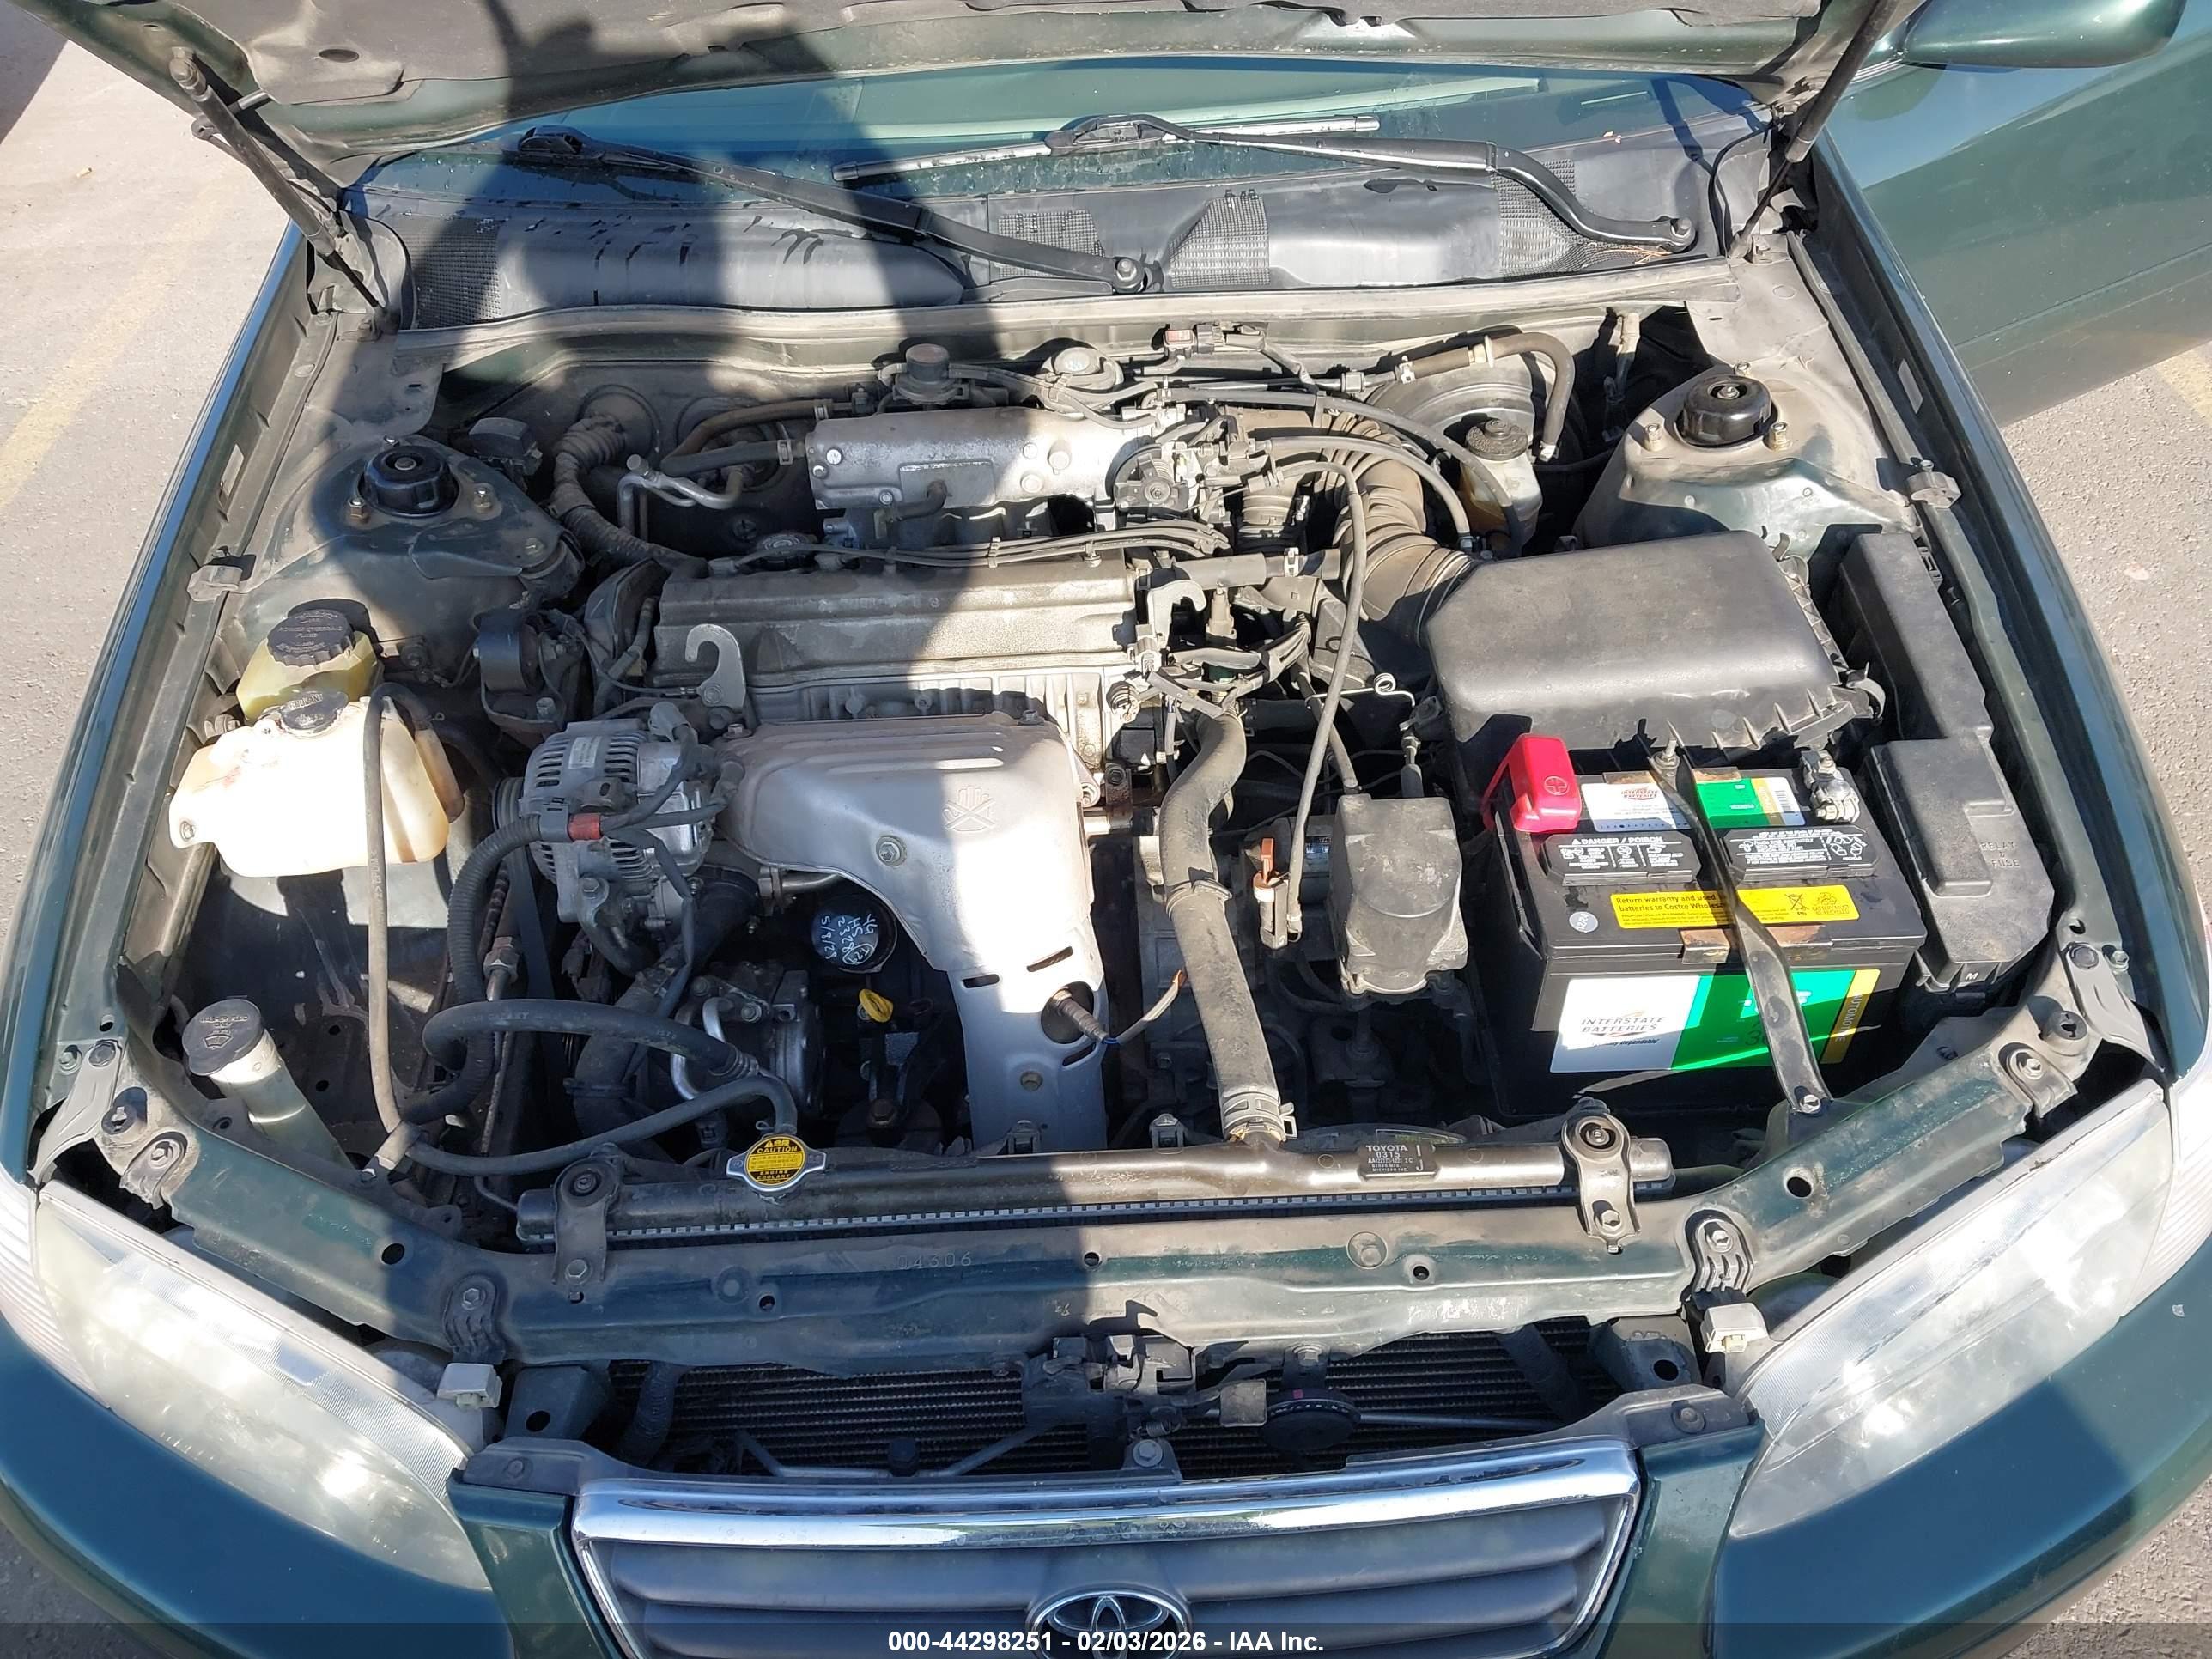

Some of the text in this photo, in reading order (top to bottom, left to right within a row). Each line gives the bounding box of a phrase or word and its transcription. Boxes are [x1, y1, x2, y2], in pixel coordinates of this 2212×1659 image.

[1979, 842, 2014, 850] RELAY
[1991, 859, 2020, 868] FUSE
[1619, 904, 1654, 913] batteries
[1966, 972, 1979, 981] M
[1581, 1017, 1666, 1025] INTERSTATE
[757, 1146, 798, 1154] CAUTION
